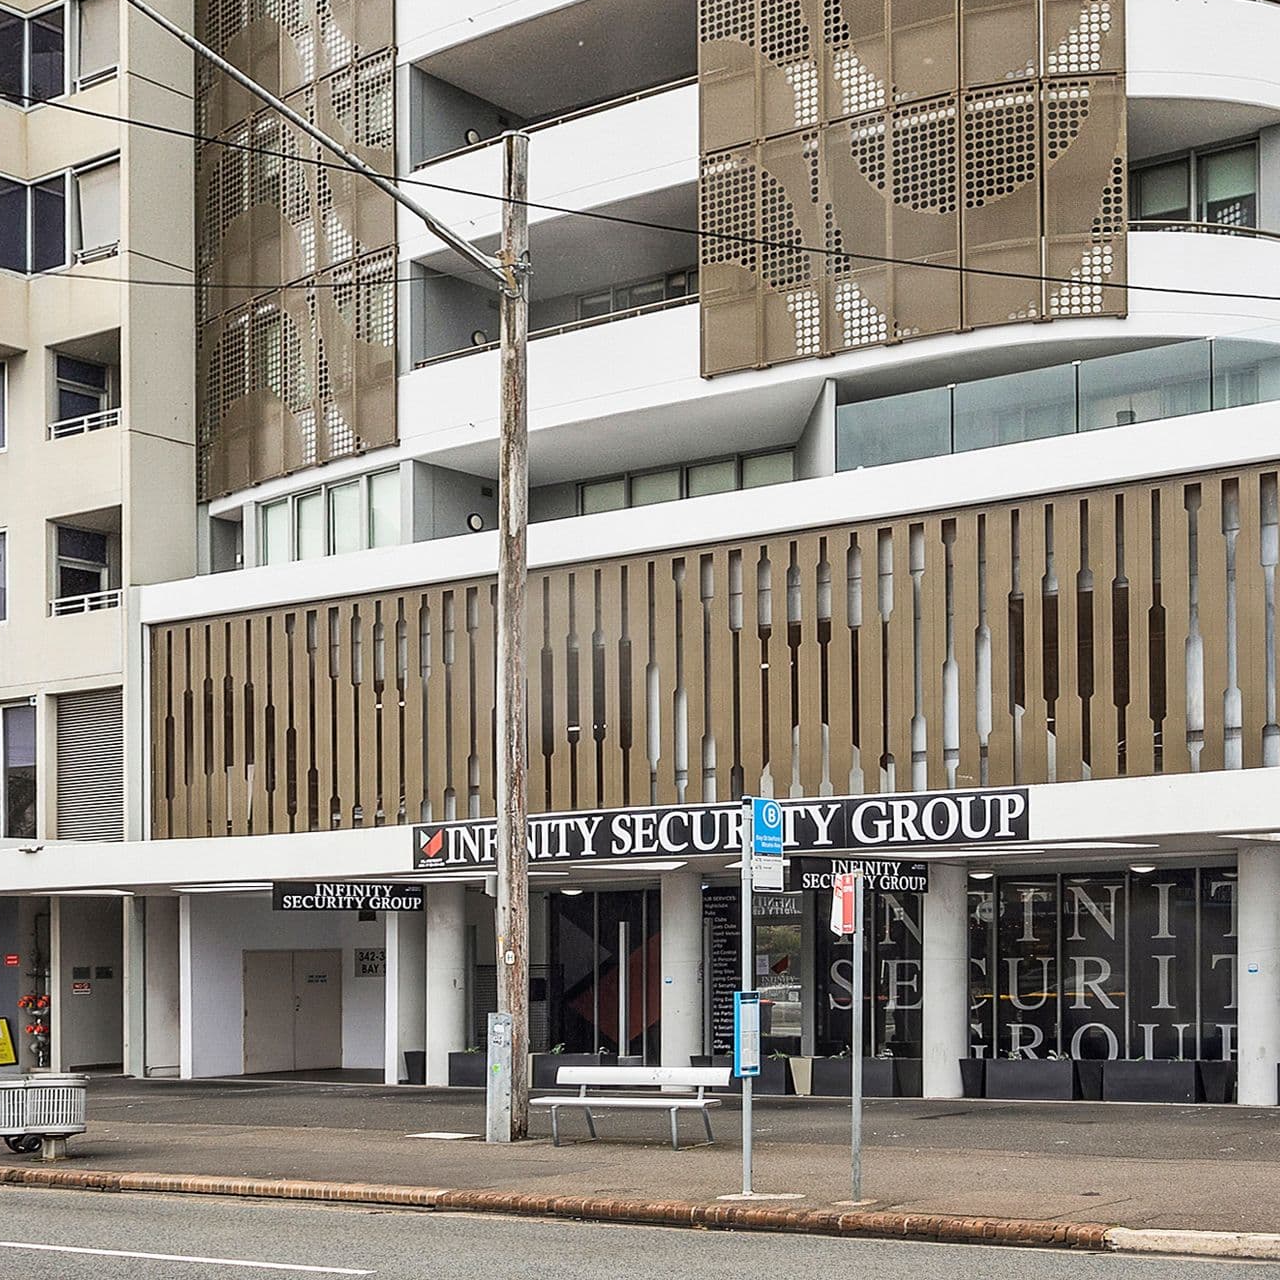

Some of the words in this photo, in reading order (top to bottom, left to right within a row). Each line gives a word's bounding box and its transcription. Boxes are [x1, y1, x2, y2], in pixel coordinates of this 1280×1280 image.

[767, 807, 776, 823] B
[445, 816, 604, 864] INFNITY
[611, 804, 842, 857] SECURTY
[852, 793, 1025, 845] GROUP
[831, 859, 902, 876] INFINITY
[802, 873, 879, 890] SECY
[879, 875, 927, 891] GROUP
[314, 883, 393, 898] INFINITY
[283, 895, 366, 909] SECURITY
[369, 897, 422, 910] GROUP
[358, 951, 386, 961] 342-3
[361, 964, 380, 973] BAY
